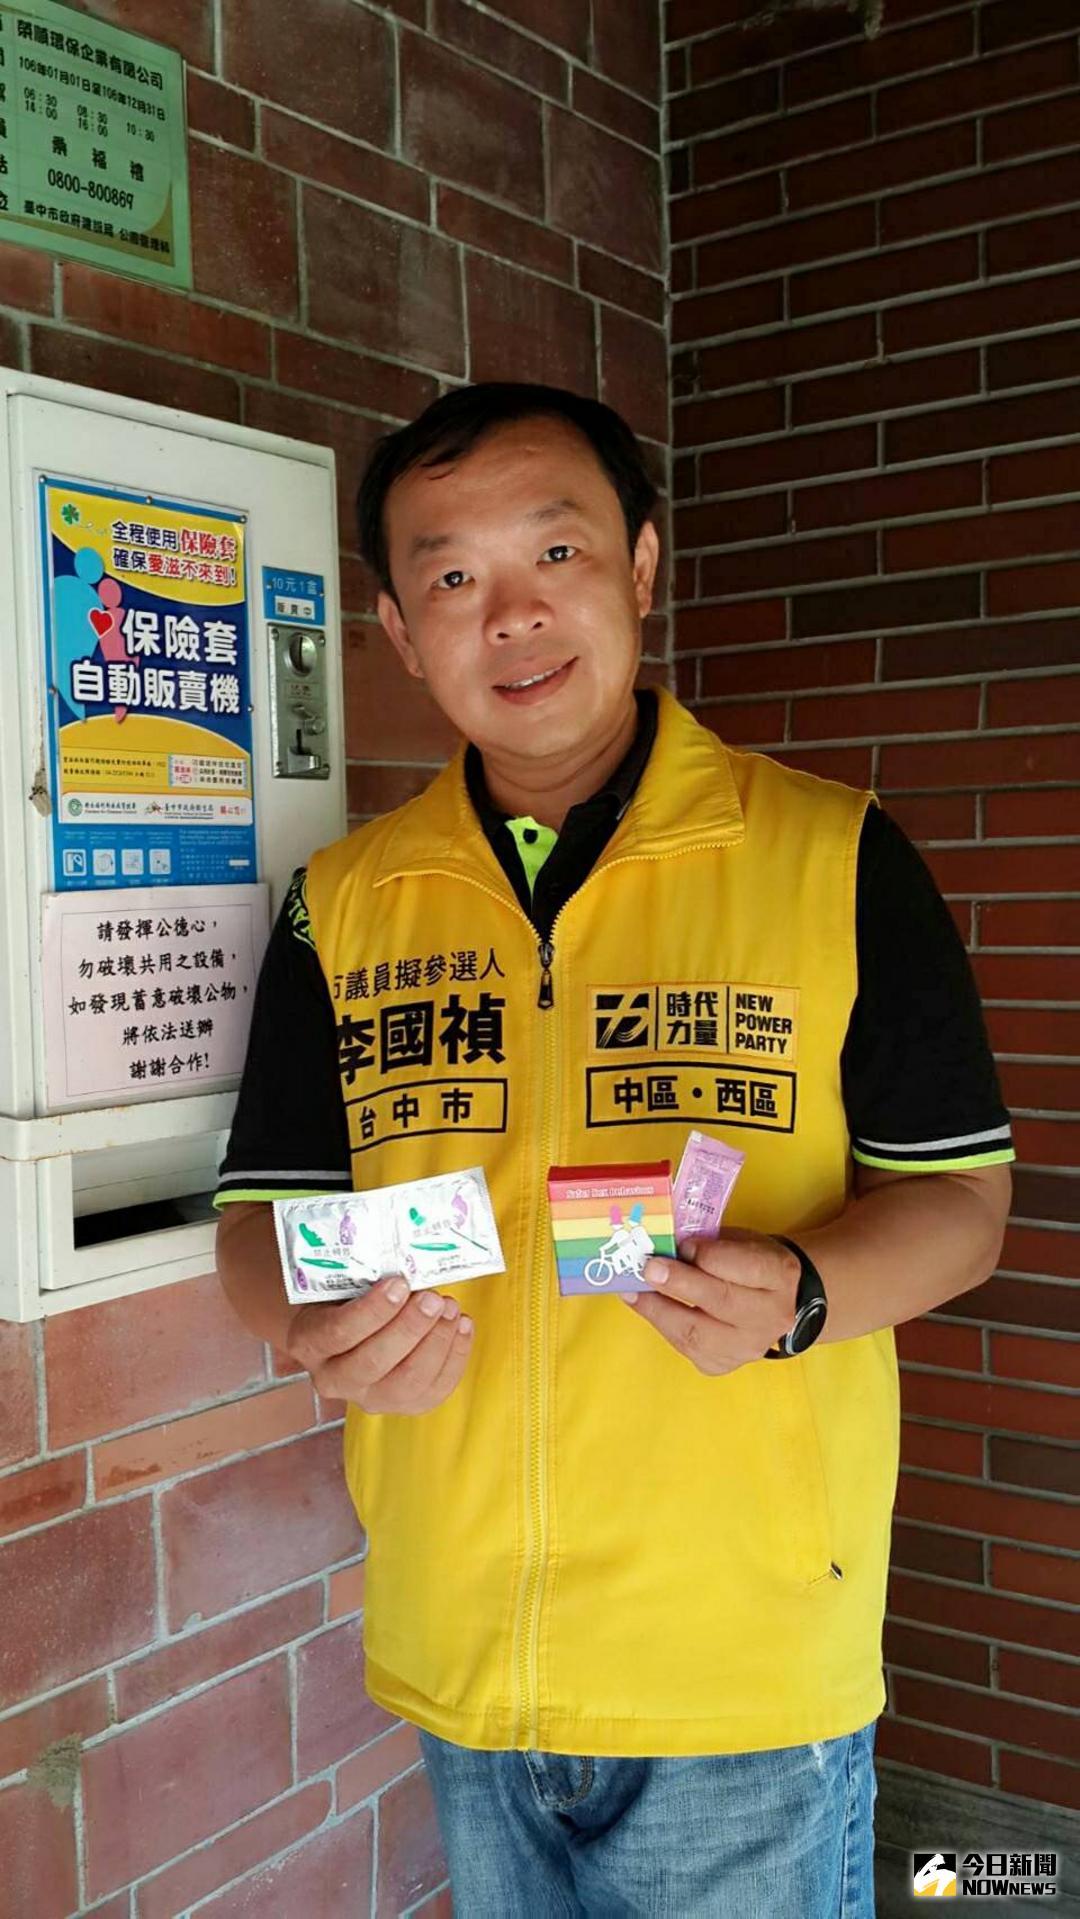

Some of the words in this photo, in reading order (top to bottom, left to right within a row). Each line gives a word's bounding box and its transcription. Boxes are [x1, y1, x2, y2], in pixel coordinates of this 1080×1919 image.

[47, 169, 134, 210] 0800-800869
[112, 521, 237, 560] 全程使用保險套
[122, 608, 238, 666] 保險套
[72, 660, 240, 714] 自動販賣機
[666, 991, 719, 1018] 時代
[735, 992, 774, 1012] NEW
[666, 1019, 719, 1046] 力量
[735, 1012, 793, 1035] POWER
[735, 1032, 788, 1054] PARTY
[129, 1052, 209, 1080] 謝謝合作!
[359, 1088, 473, 1140] 台中市
